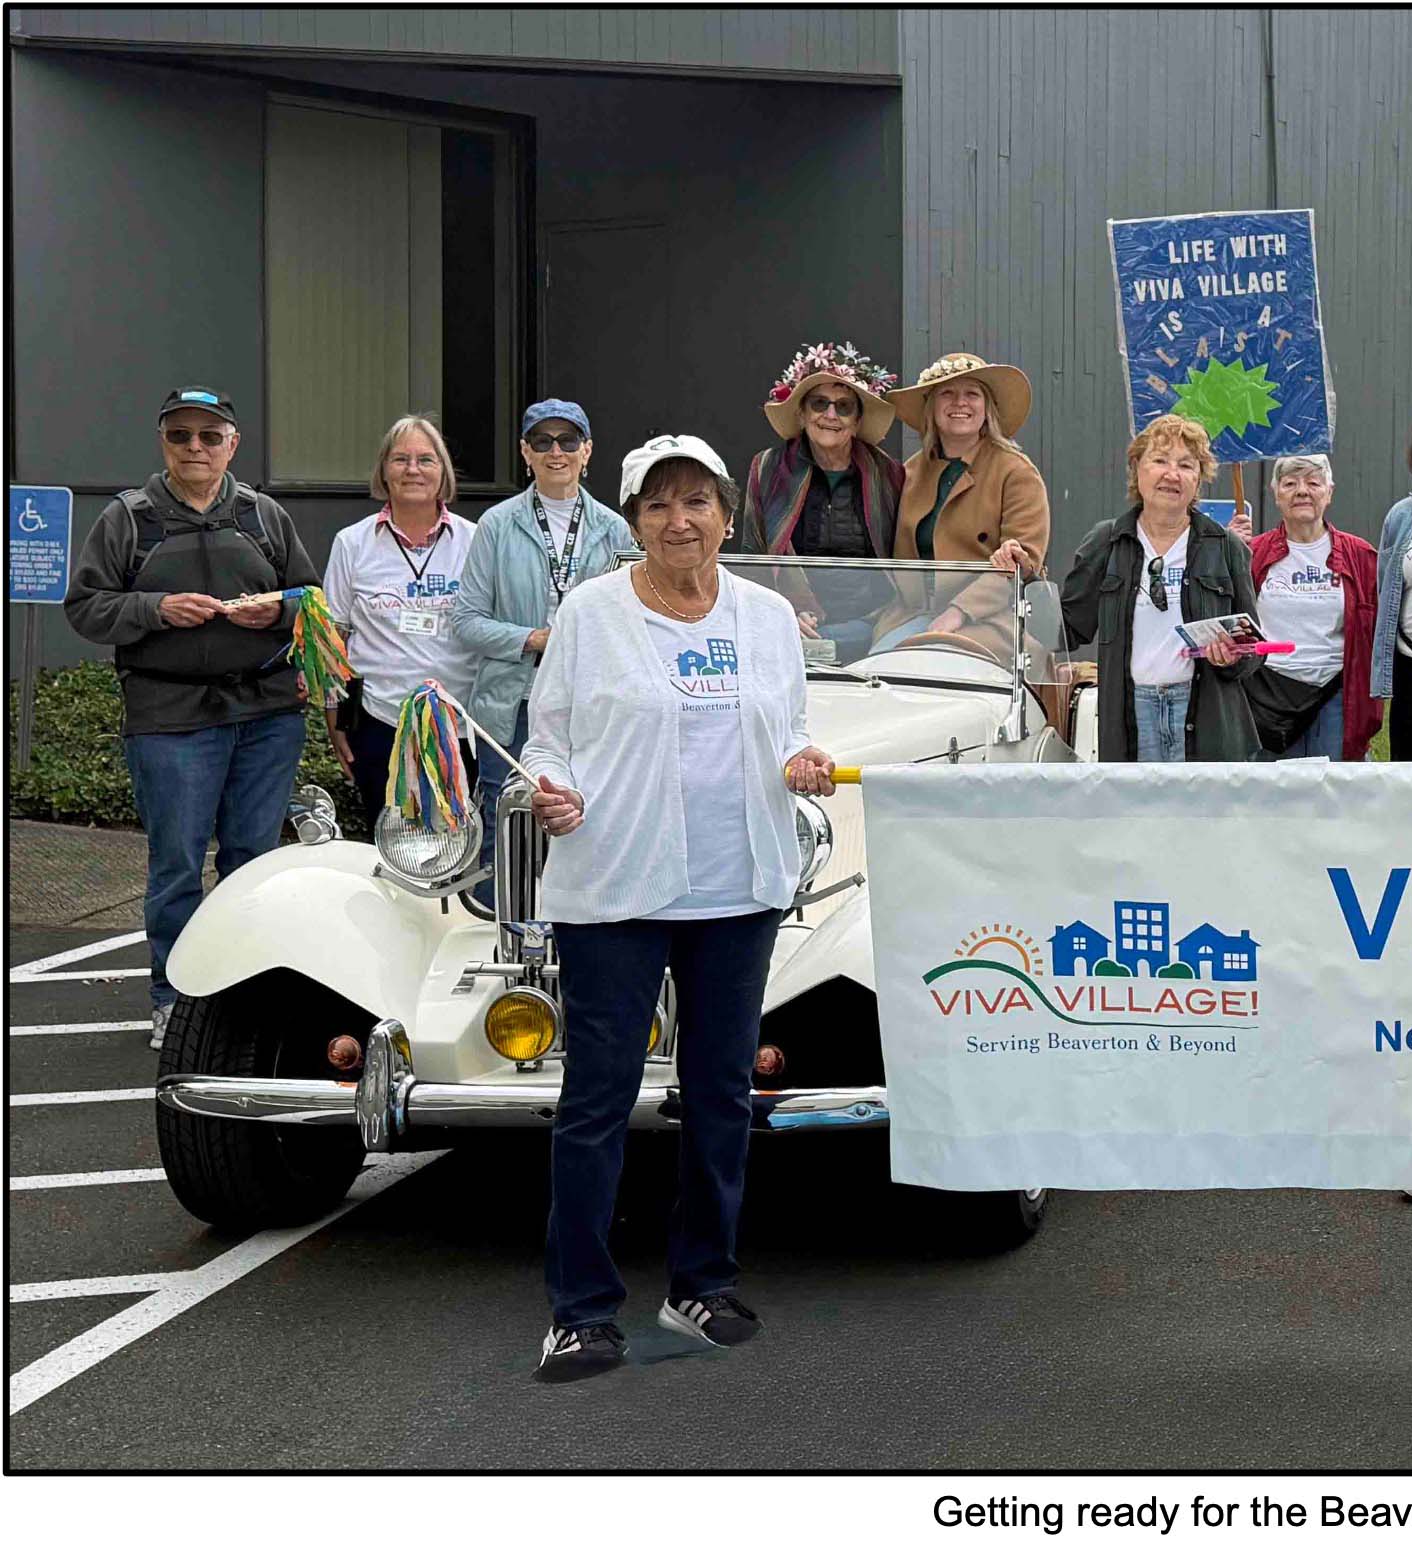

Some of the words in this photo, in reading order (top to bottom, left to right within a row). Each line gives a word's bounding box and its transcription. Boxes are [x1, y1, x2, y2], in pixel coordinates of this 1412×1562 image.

[1168, 239, 1217, 264] LIFE
[1230, 233, 1287, 258] WITH
[1133, 277, 1185, 302] VIVA
[1198, 270, 1288, 297] VILLAGE
[1158, 310, 1184, 341] IS
[1257, 305, 1272, 328] A
[369, 600, 401, 610] VIVA
[682, 702, 732, 712] Beaverton
[930, 987, 1035, 1016] VIVA
[1055, 986, 1260, 1016] VILLAGE!
[967, 1033, 1041, 1056] Serving
[1047, 1030, 1140, 1053] Beaverton
[1146, 1031, 1163, 1052] &
[1168, 1031, 1238, 1056] Beyond
